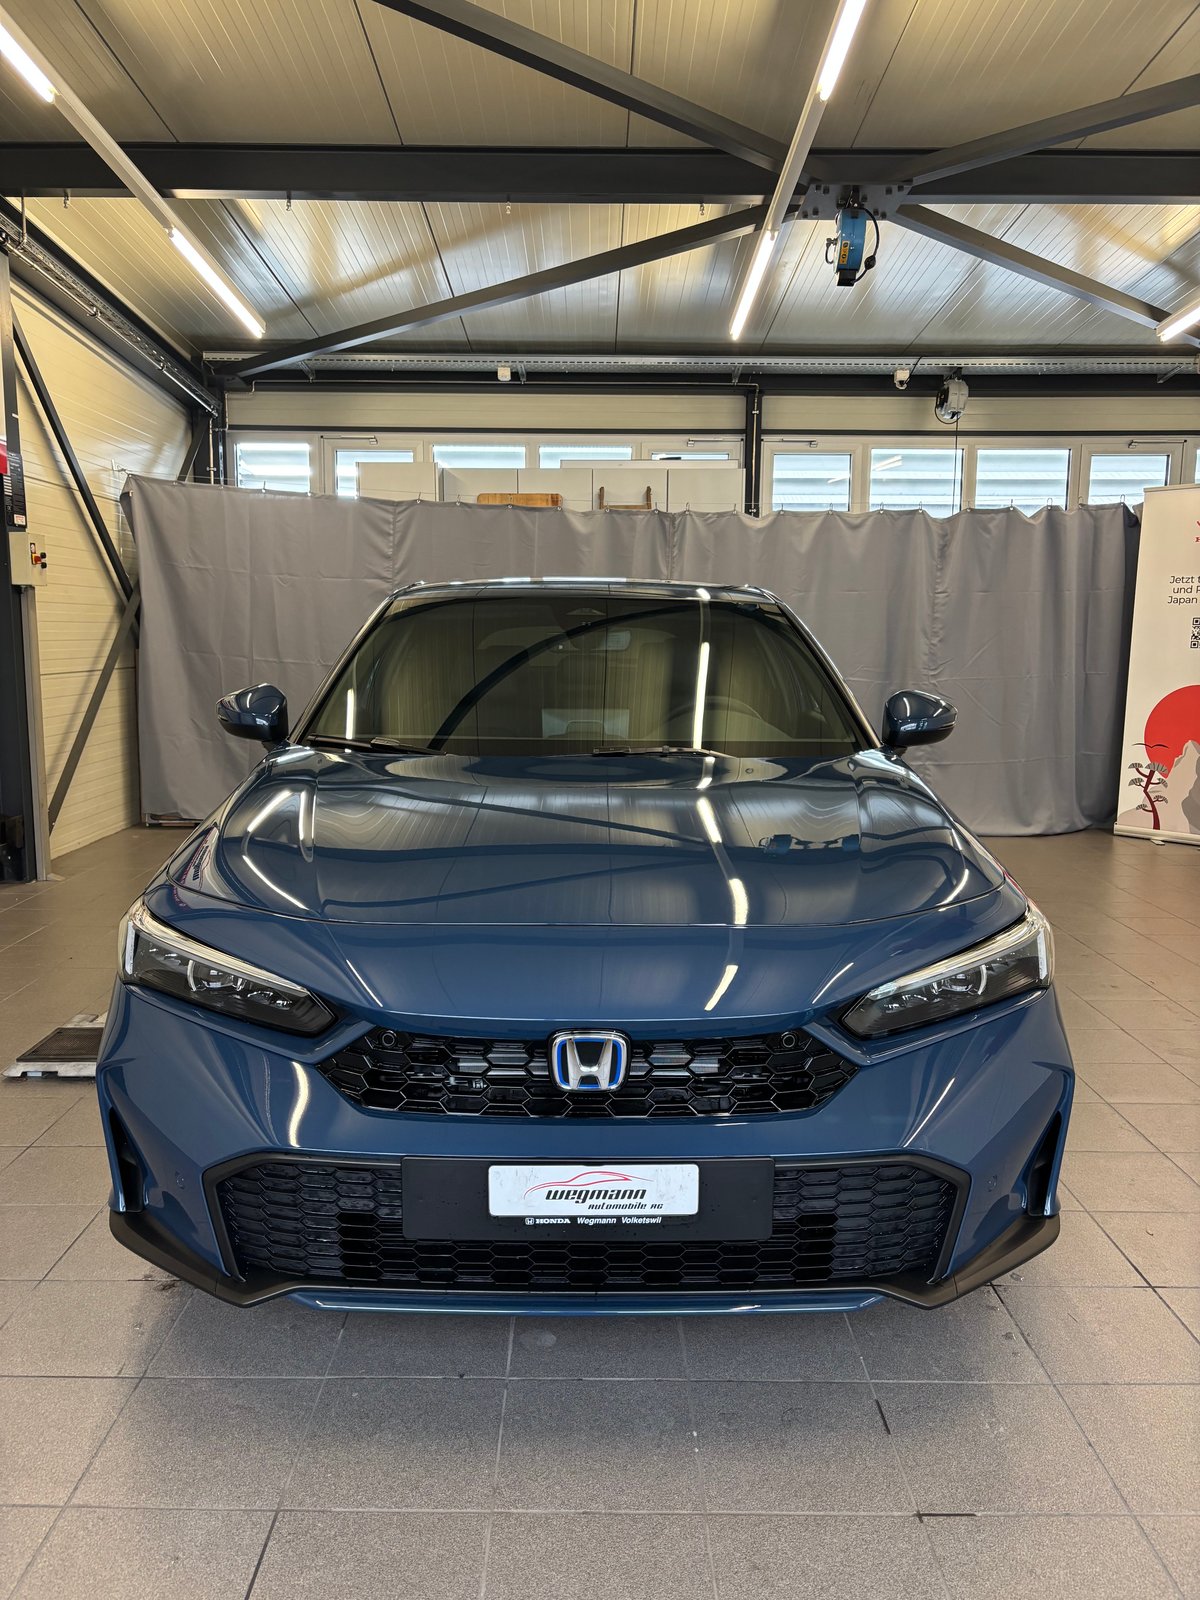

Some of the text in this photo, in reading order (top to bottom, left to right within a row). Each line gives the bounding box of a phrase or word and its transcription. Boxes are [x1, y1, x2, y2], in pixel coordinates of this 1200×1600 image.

[1169, 575, 1195, 584] Jetzt
[1172, 585, 1193, 594] und
[1167, 595, 1198, 606] Japan
[545, 1189, 647, 1203] wegmann
[587, 1202, 647, 1210] automobile
[577, 1216, 617, 1226] Wegmann
[621, 1216, 662, 1225] Volketswil
